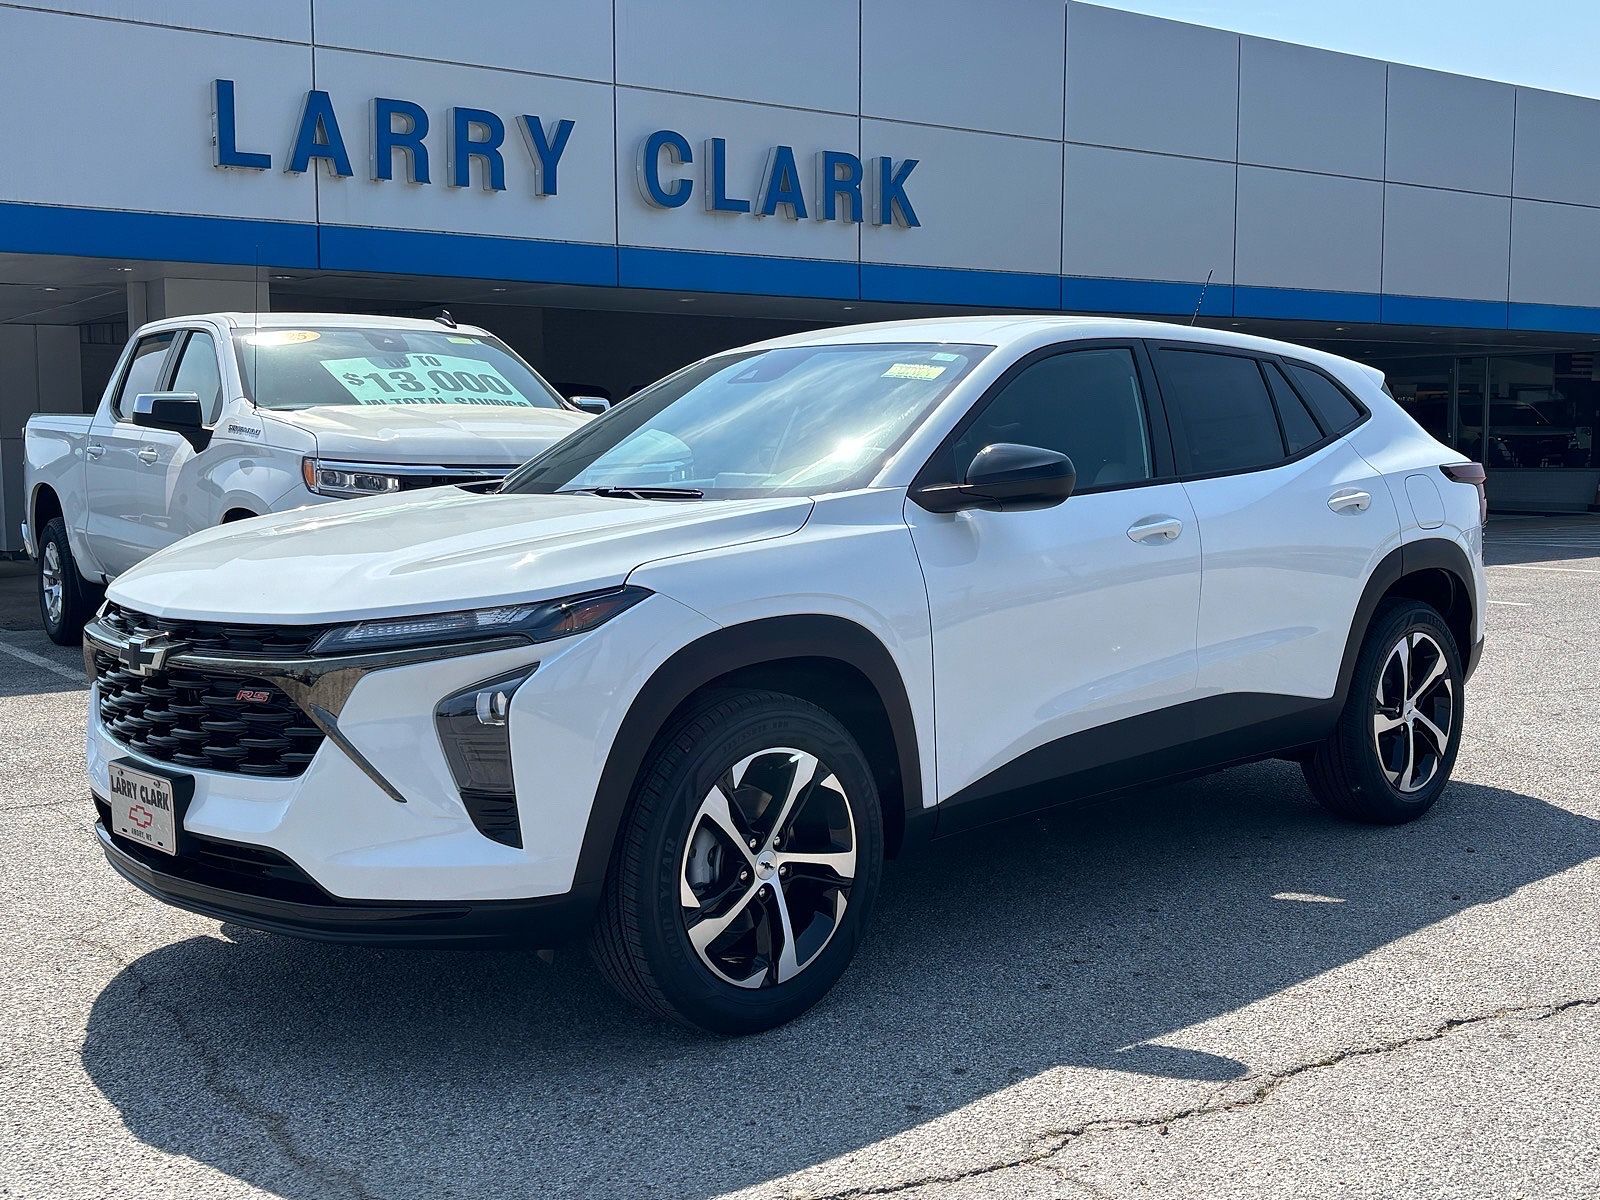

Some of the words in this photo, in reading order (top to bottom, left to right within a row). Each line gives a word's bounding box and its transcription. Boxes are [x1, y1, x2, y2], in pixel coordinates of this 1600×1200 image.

[210, 78, 575, 197] LARRY
[637, 129, 922, 229] CLARK
[413, 355, 442, 367] TO
[342, 369, 514, 395] $13,000
[236, 690, 270, 702] RS
[110, 774, 137, 800] LARRY
[139, 785, 170, 811] CLARK
